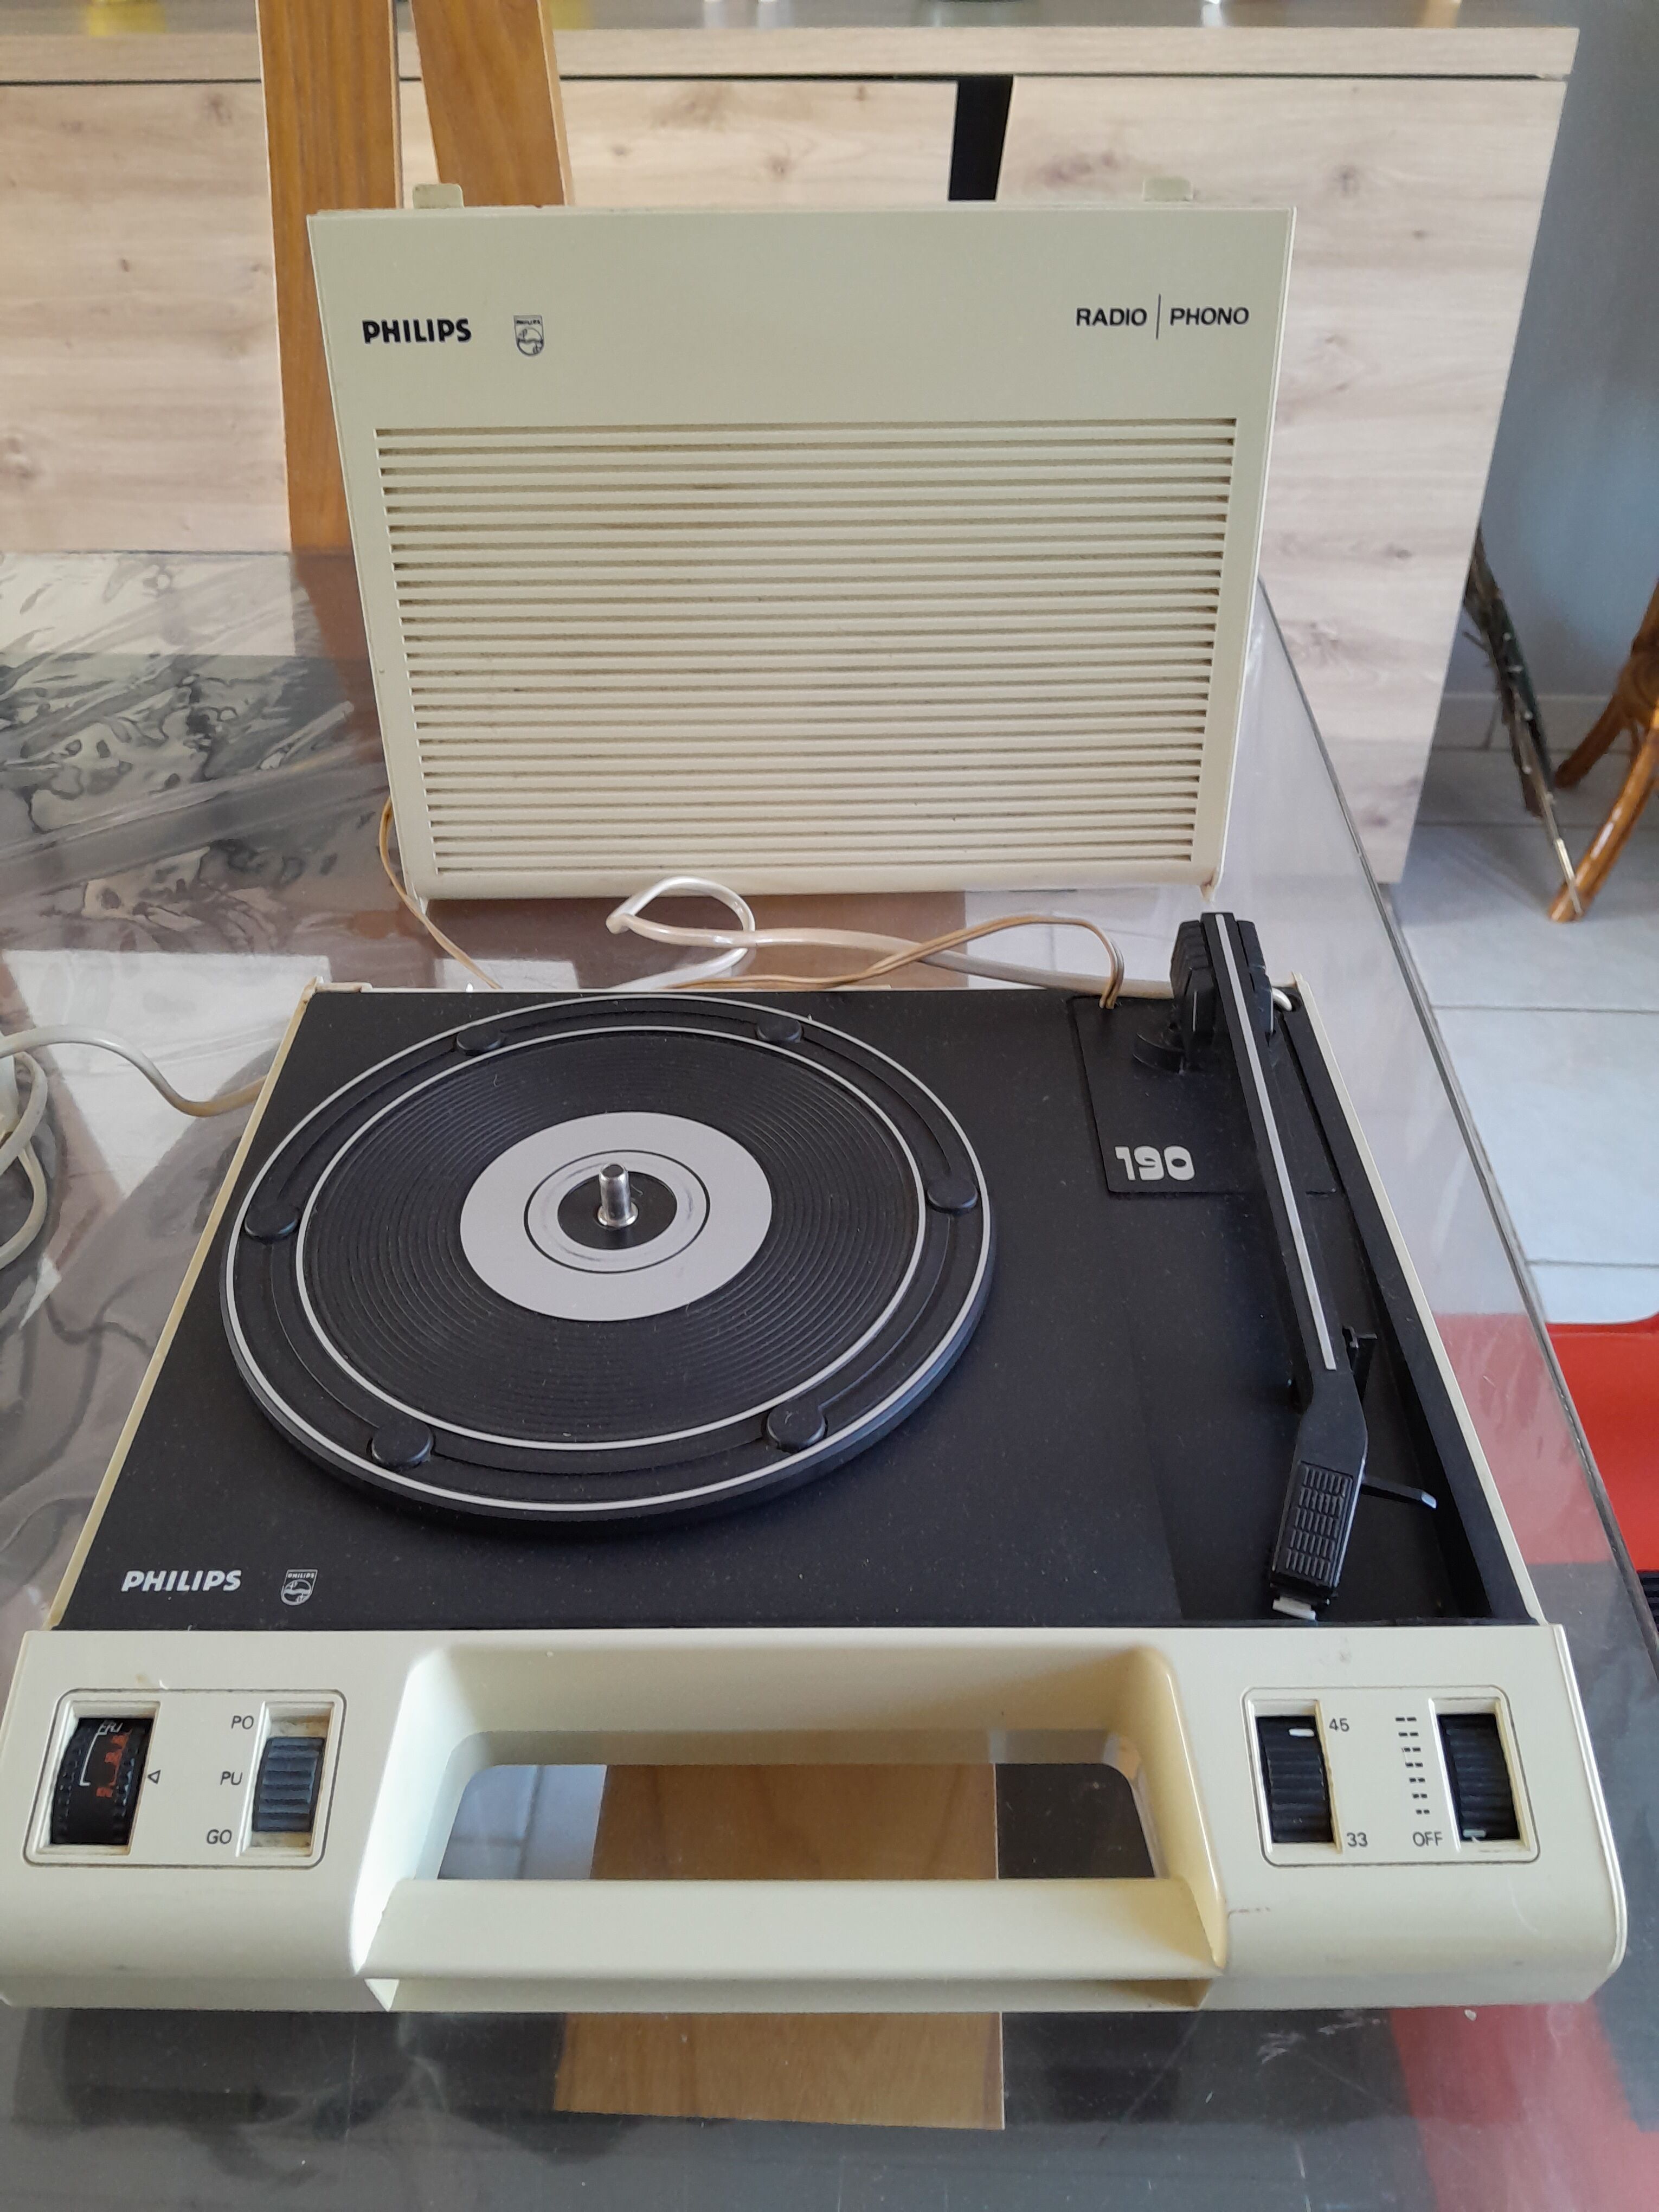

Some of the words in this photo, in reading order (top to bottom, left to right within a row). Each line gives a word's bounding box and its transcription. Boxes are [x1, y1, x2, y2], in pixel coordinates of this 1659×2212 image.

[1076, 307, 1147, 326] RADIO
[1170, 307, 1249, 326] PHONO
[363, 318, 472, 344] PHILIPS
[1115, 1145, 1195, 1181] 190
[121, 1570, 242, 1592] PHILIPS
[231, 1715, 254, 1729] PO
[1329, 1718, 1350, 1732] 45
[220, 1771, 243, 1785] PU
[207, 1829, 232, 1844] GO
[1346, 1832, 1368, 1848] 33
[1413, 1831, 1443, 1847] OFF
